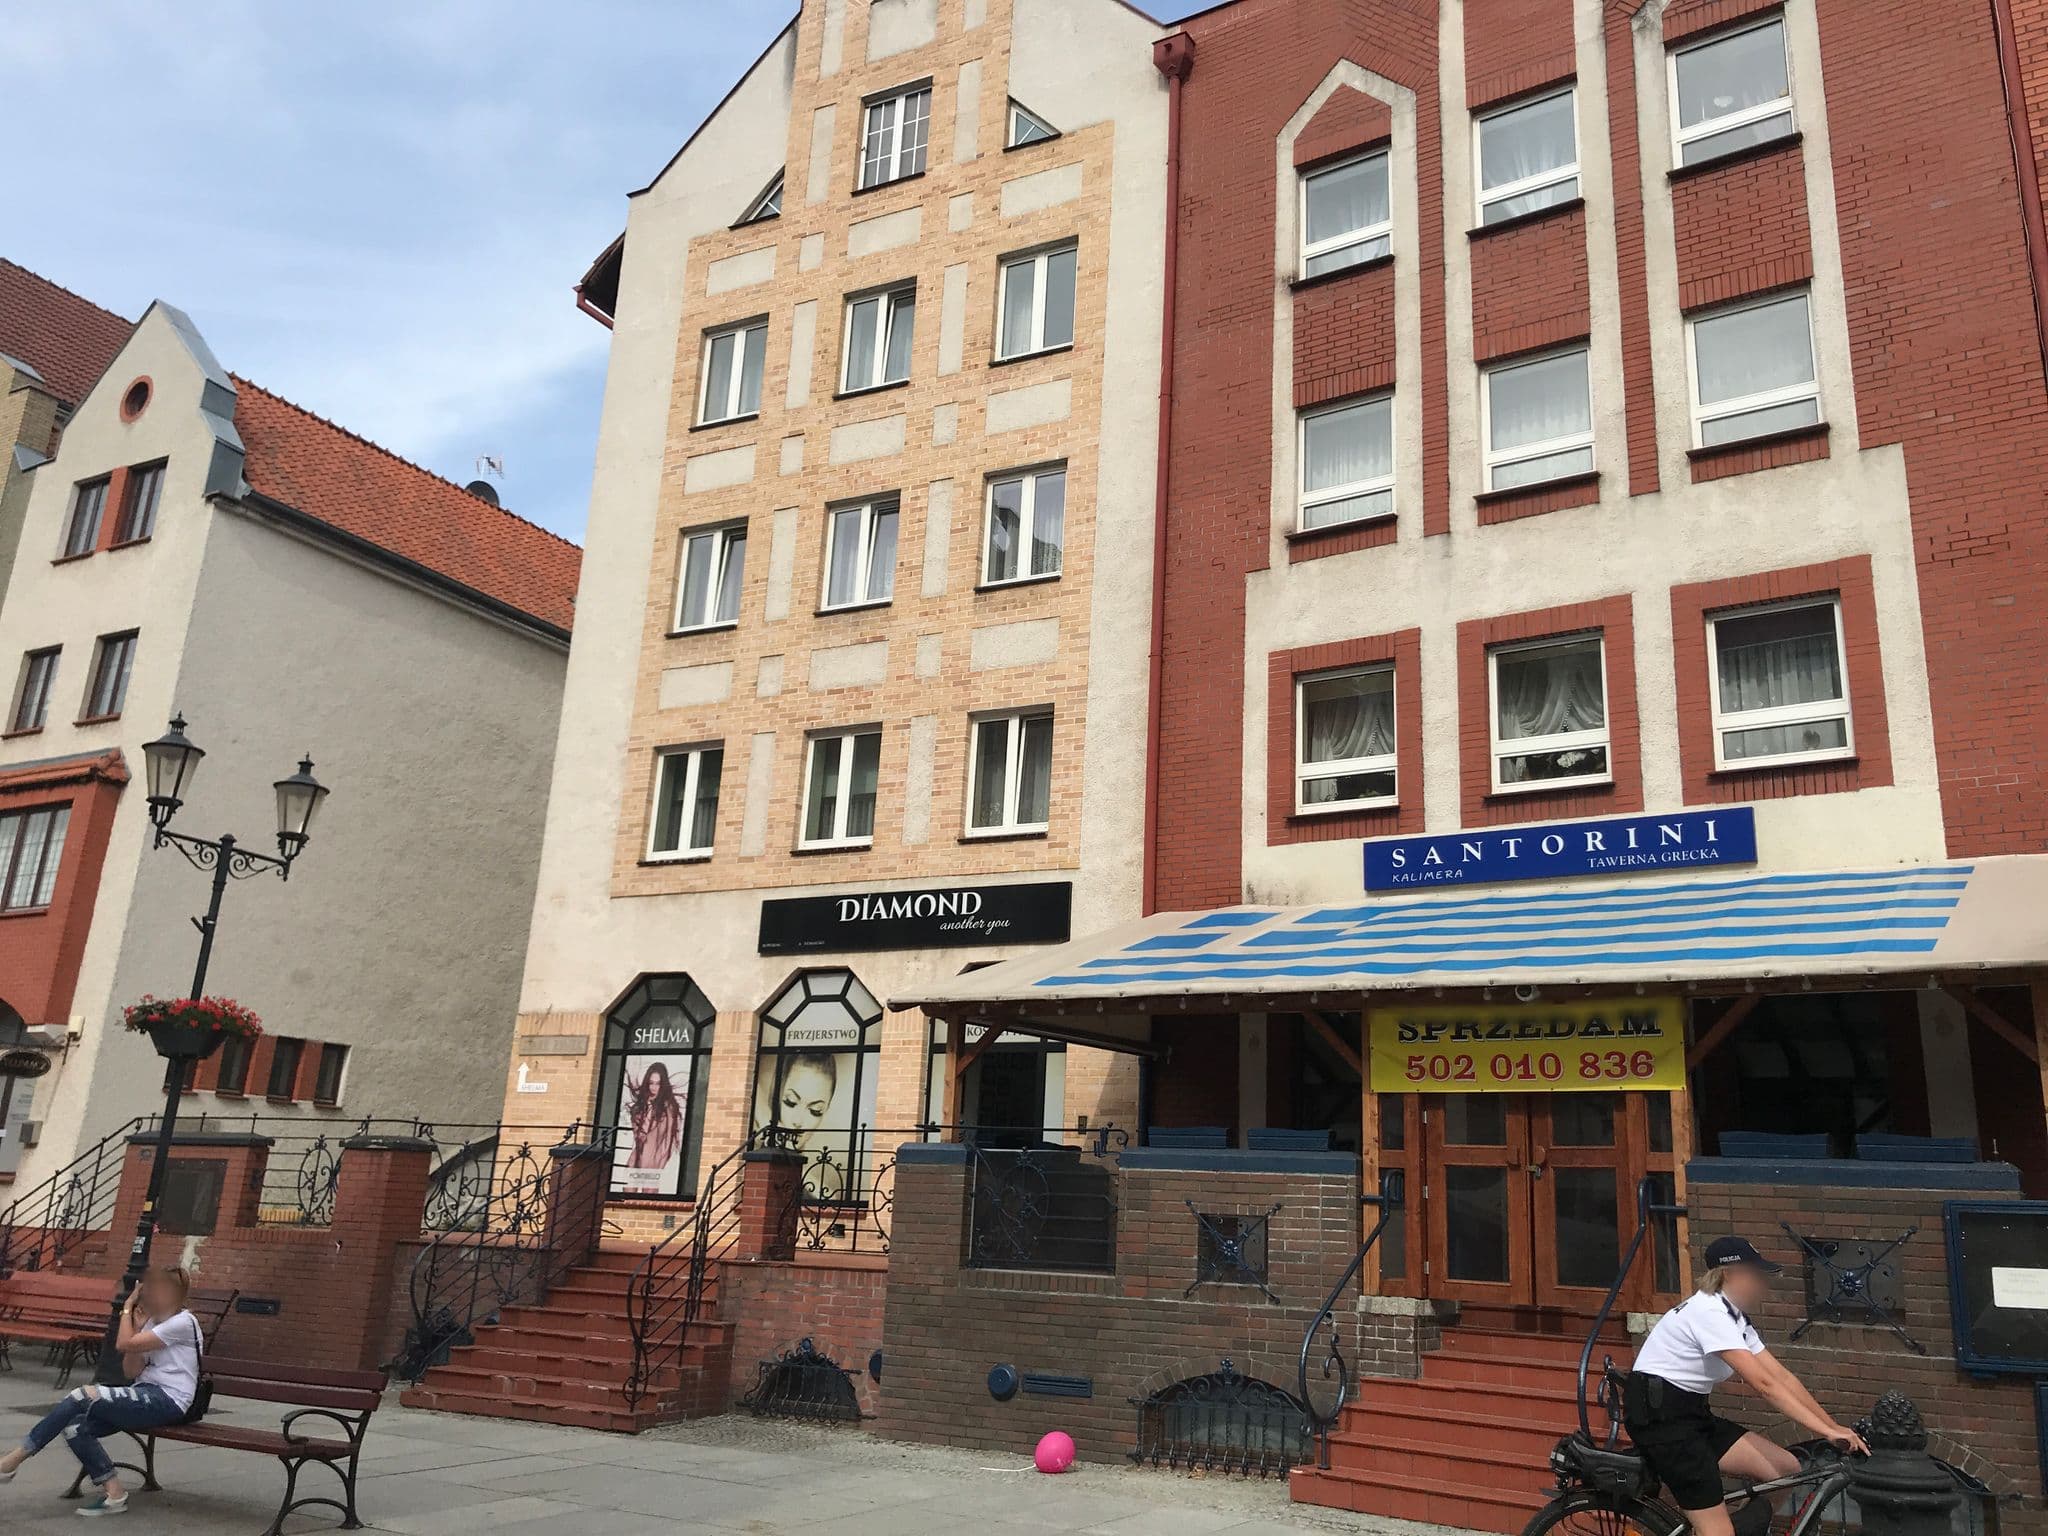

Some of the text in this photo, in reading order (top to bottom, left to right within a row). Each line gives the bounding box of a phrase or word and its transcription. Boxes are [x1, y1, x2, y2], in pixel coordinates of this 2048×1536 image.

[1391, 819, 1719, 868] SANTORINI
[1587, 848, 1719, 868] TAWERNA GRECKA
[1392, 869, 1463, 883] KALIMERA
[939, 916, 1011, 935] another you
[634, 1028, 690, 1043] SHELMA
[787, 1029, 858, 1041] FRYZJERSTWO
[1398, 1010, 1663, 1043] SPRZEDAM
[1404, 1050, 1656, 1082] 502 010 836
[1719, 1254, 1741, 1263] POLICJA
